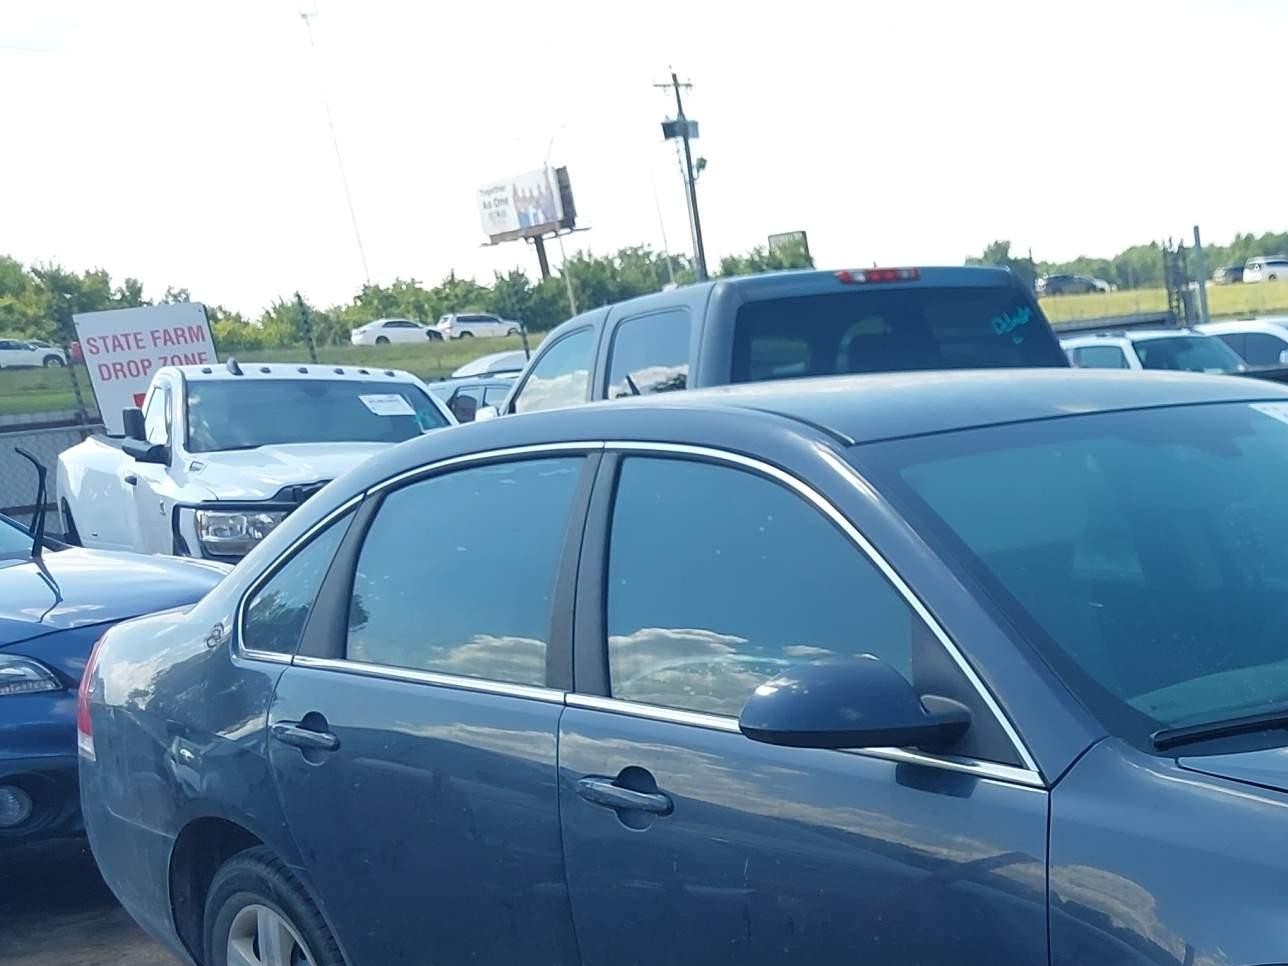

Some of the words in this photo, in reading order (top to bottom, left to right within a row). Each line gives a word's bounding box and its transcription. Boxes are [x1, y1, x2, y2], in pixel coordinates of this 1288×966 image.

[86, 331, 146, 356] STATE
[150, 325, 206, 348] FARM
[97, 357, 152, 382] DROP
